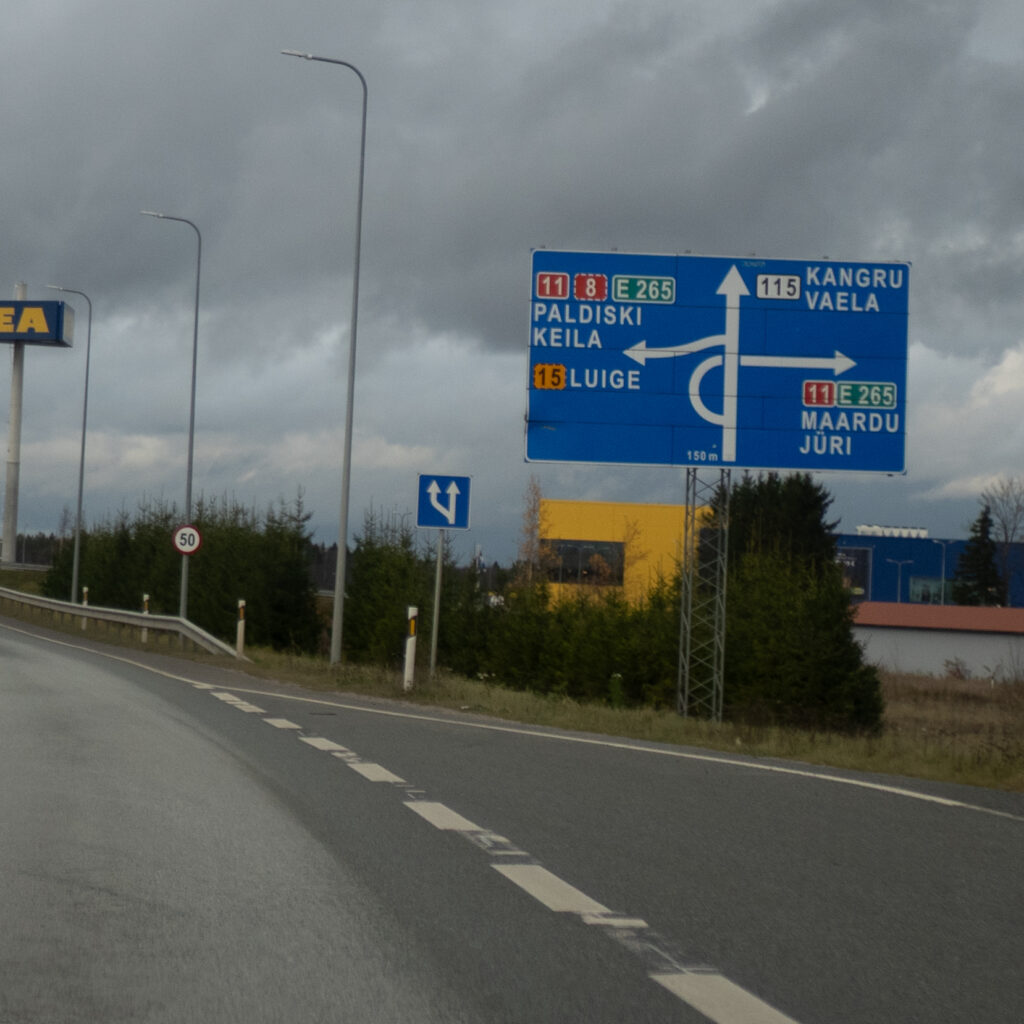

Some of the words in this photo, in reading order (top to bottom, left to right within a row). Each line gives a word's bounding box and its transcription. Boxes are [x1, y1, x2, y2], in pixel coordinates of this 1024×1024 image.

[542, 276, 563, 296] 11
[585, 278, 597, 297] 8
[617, 279, 629, 298] E
[636, 280, 672, 300] 265
[761, 277, 797, 297] 115
[806, 266, 903, 289] KANGRU
[805, 290, 880, 312] VAELA
[533, 302, 642, 326] PALDISKI
[533, 327, 602, 349] KEILA
[538, 367, 562, 387] 15
[570, 368, 641, 389] LUIGE
[808, 384, 830, 400] 11
[801, 410, 899, 433] MAARDU
[799, 431, 852, 455] JÜRI
[687, 450, 707, 461] 150
[708, 453, 718, 461] m
[180, 533, 195, 546] 50
